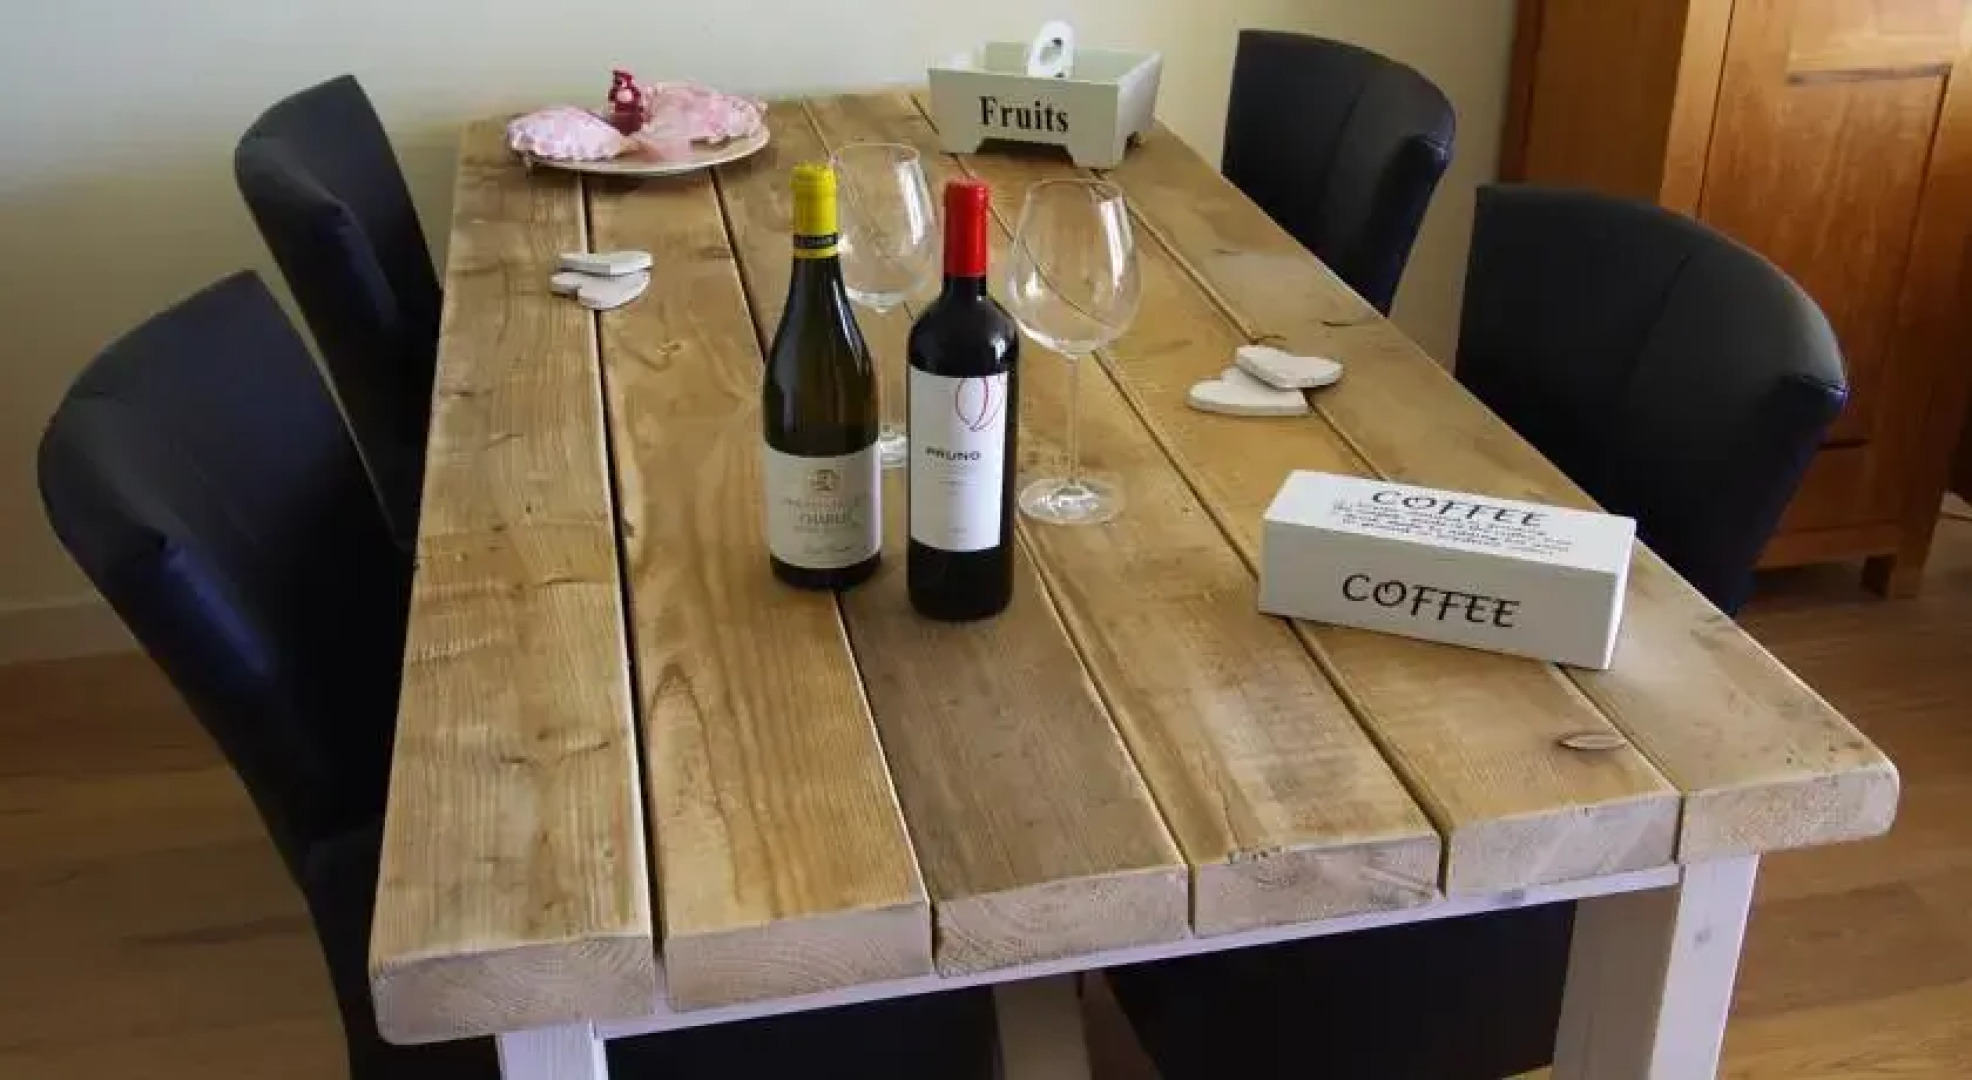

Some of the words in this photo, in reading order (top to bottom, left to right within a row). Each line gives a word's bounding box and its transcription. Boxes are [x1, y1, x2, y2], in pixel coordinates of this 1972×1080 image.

[978, 95, 1069, 133] Fruits
[925, 446, 982, 461] PRUNO
[1372, 490, 1548, 526] COFFEE
[1341, 572, 1521, 629] COFFEE
